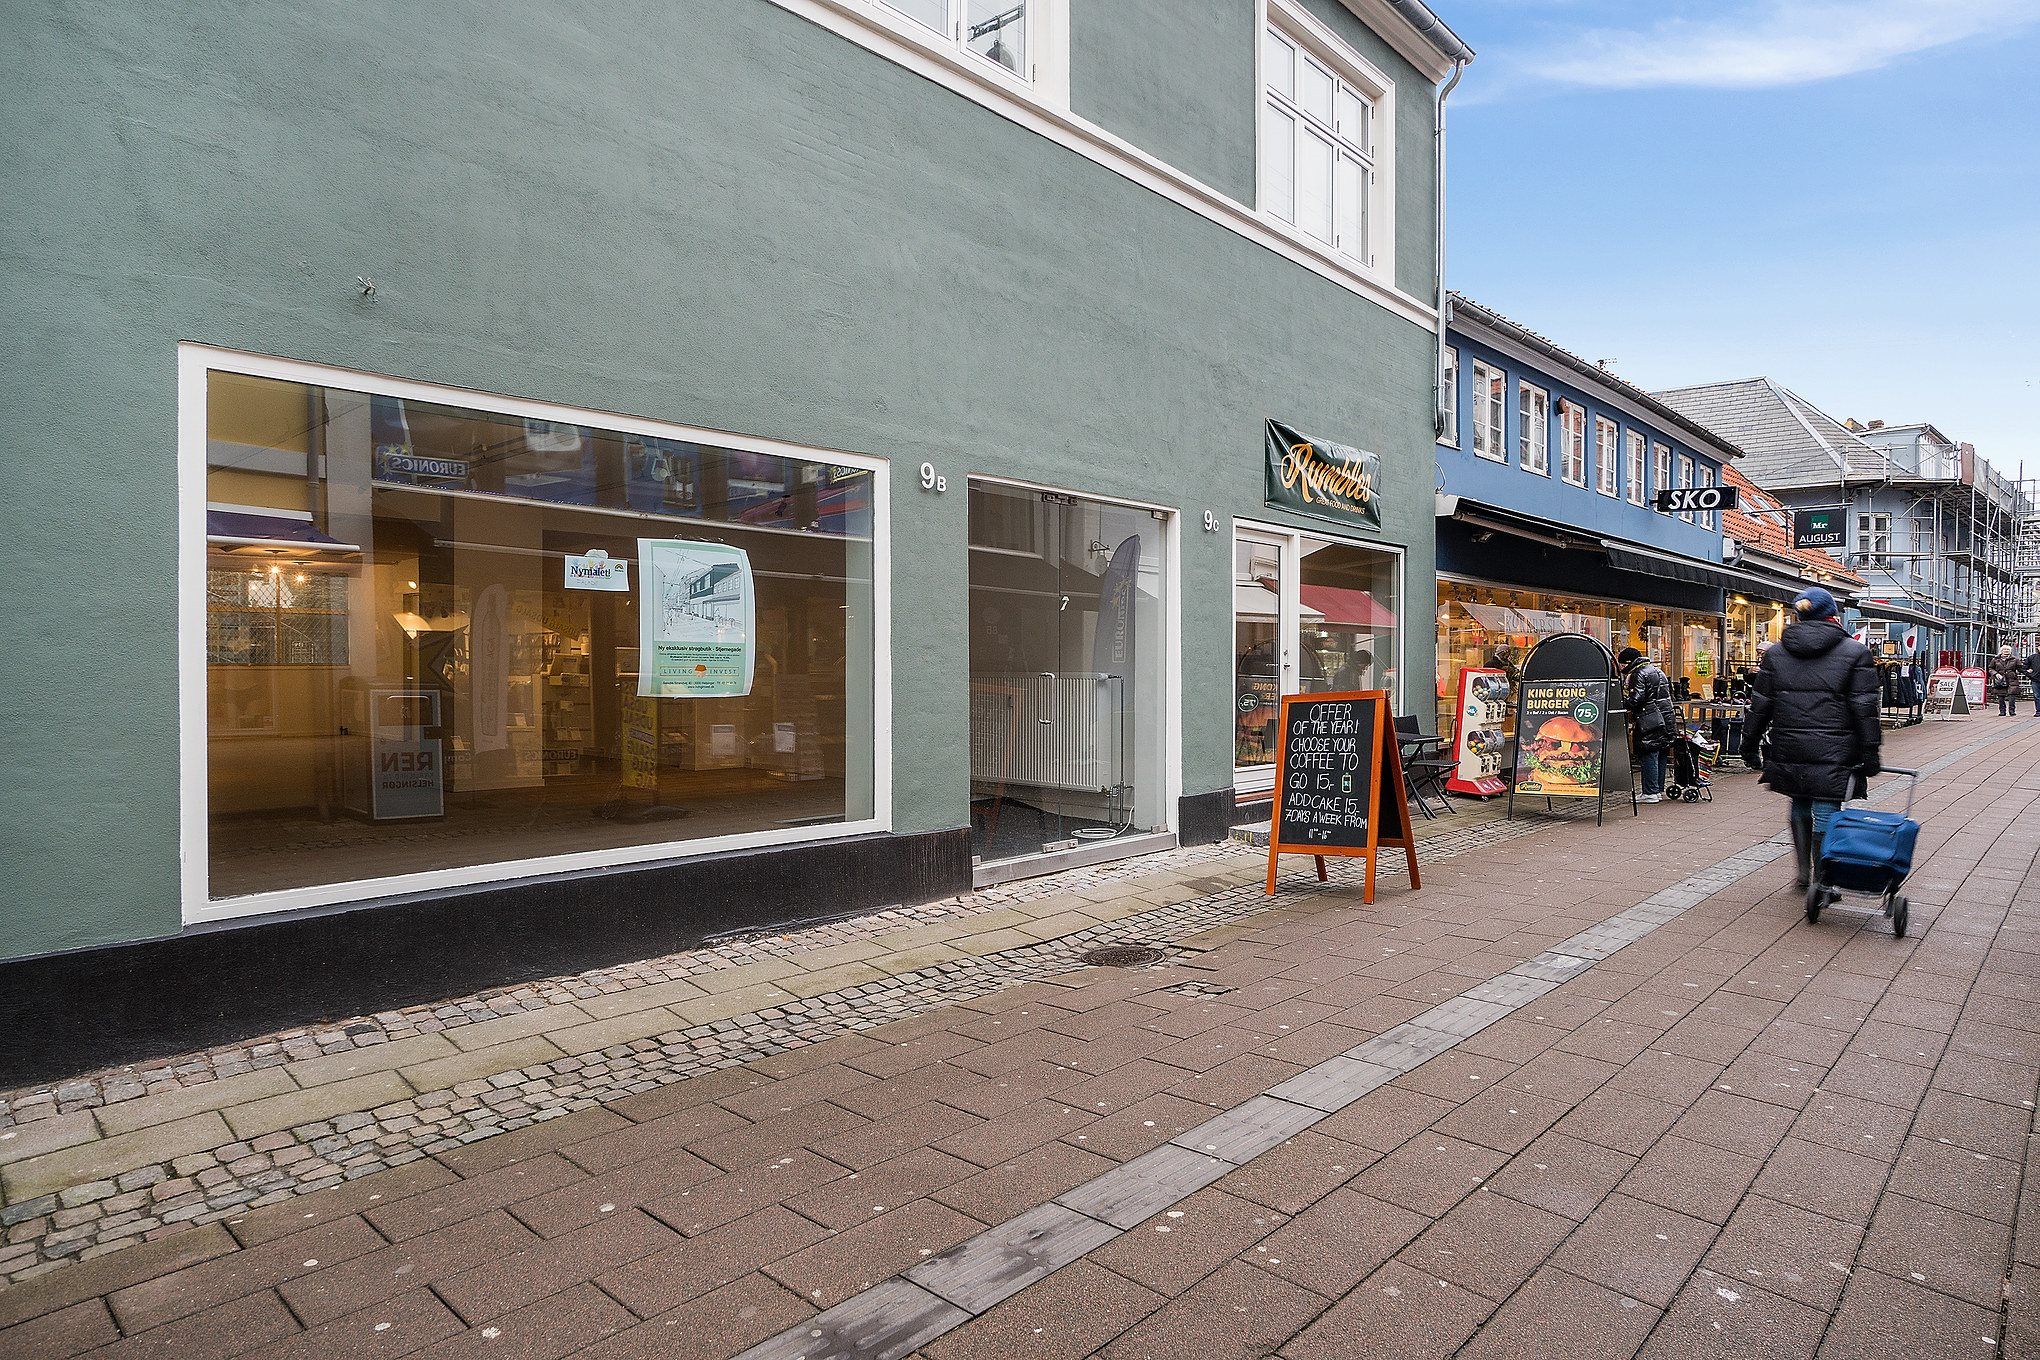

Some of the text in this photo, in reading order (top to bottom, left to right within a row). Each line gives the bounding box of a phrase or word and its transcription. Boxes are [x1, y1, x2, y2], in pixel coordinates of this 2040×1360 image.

[920, 462, 946, 491] 9B
[1281, 443, 1371, 503] Rumbles
[1316, 497, 1365, 514] GREAT FOOD AND DRINKS
[1668, 488, 1720, 510] SKO
[1799, 533, 1841, 543] AUGUST
[571, 566, 611, 578] Nymalet!
[1527, 688, 1586, 698] KING KONG
[1310, 703, 1352, 721] OFFER
[1527, 699, 1570, 709] BURGER
[1578, 708, 1596, 719] 75,-
[1293, 719, 1359, 735] OF THE YEAR!
[1291, 737, 1356, 752] CHOOSE YOUR
[1290, 752, 1359, 771] COFFEE TO
[1289, 772, 1308, 789] GO
[1311, 795, 1342, 812] CAKE
[1344, 814, 1368, 830] FROM
